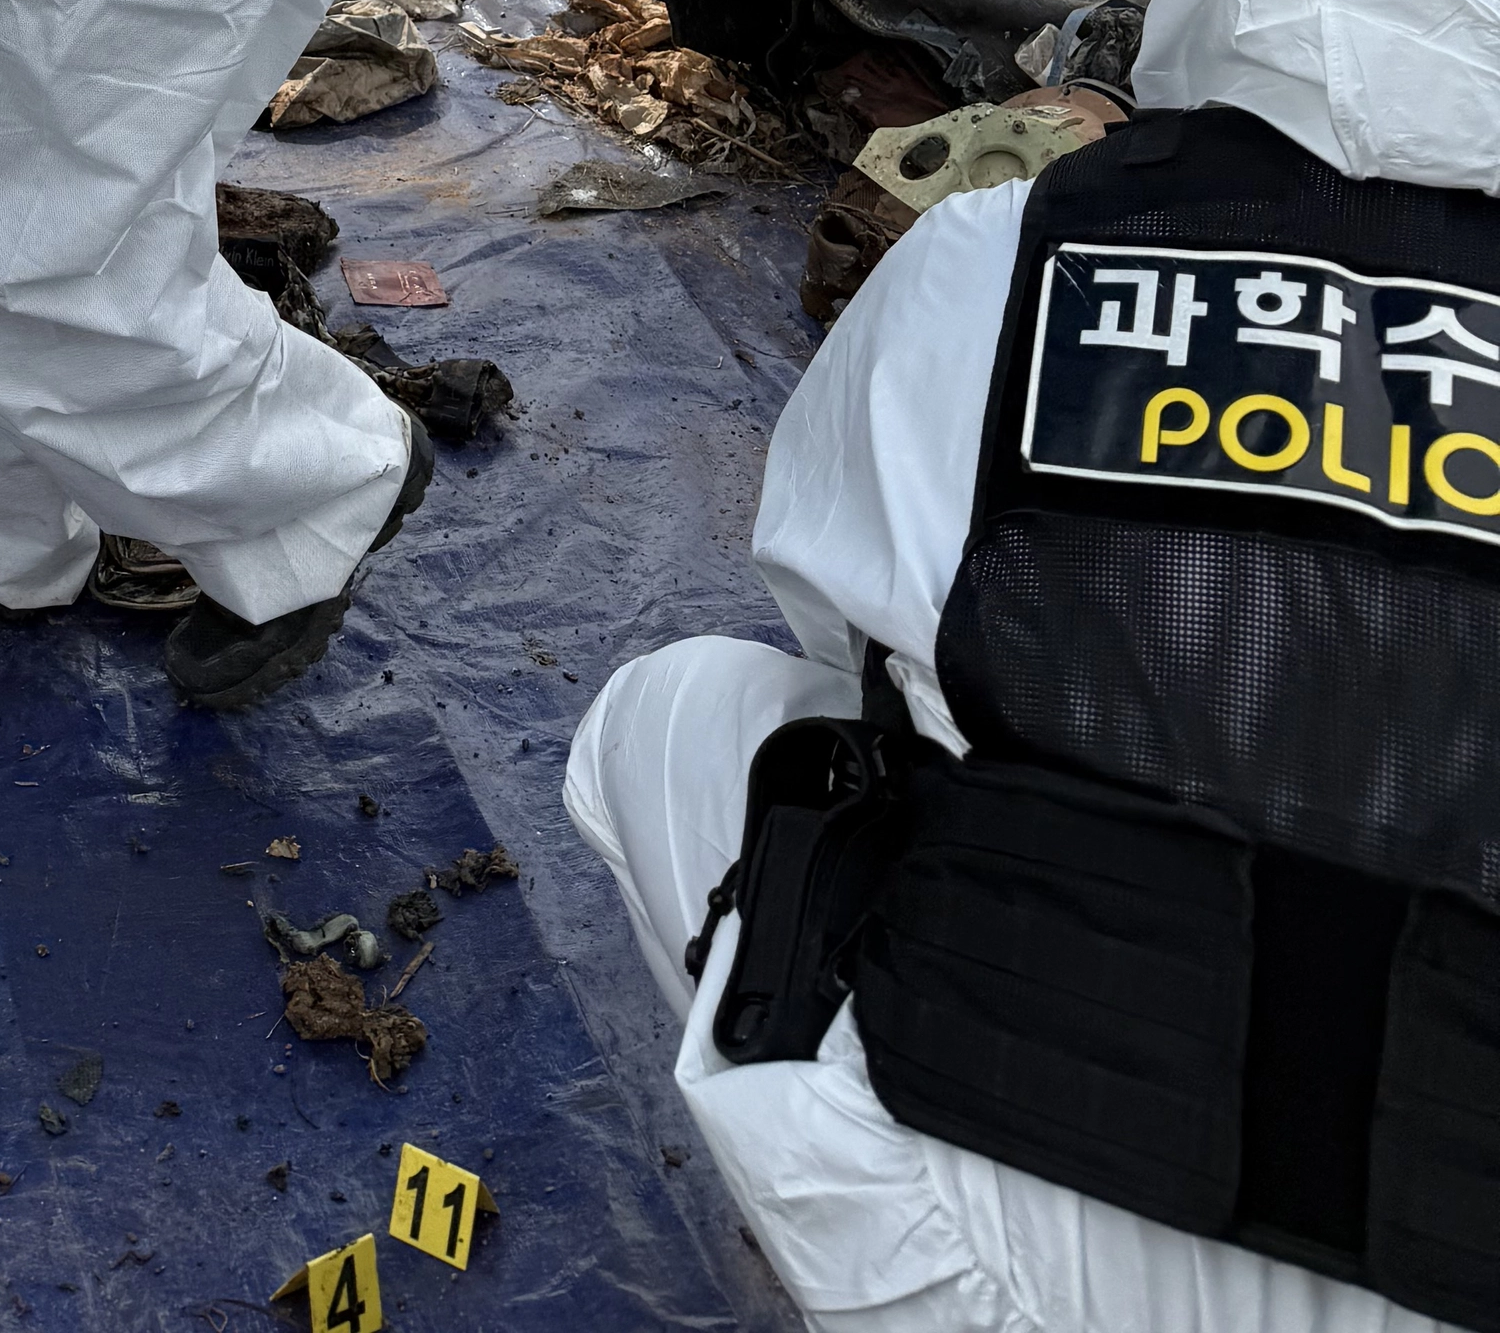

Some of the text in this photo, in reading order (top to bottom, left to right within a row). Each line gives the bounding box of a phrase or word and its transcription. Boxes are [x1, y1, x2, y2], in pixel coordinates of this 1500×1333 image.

[1080, 269, 1500, 406] 과학수
[406, 1165, 466, 1260] 11
[327, 1254, 366, 1333] 4
